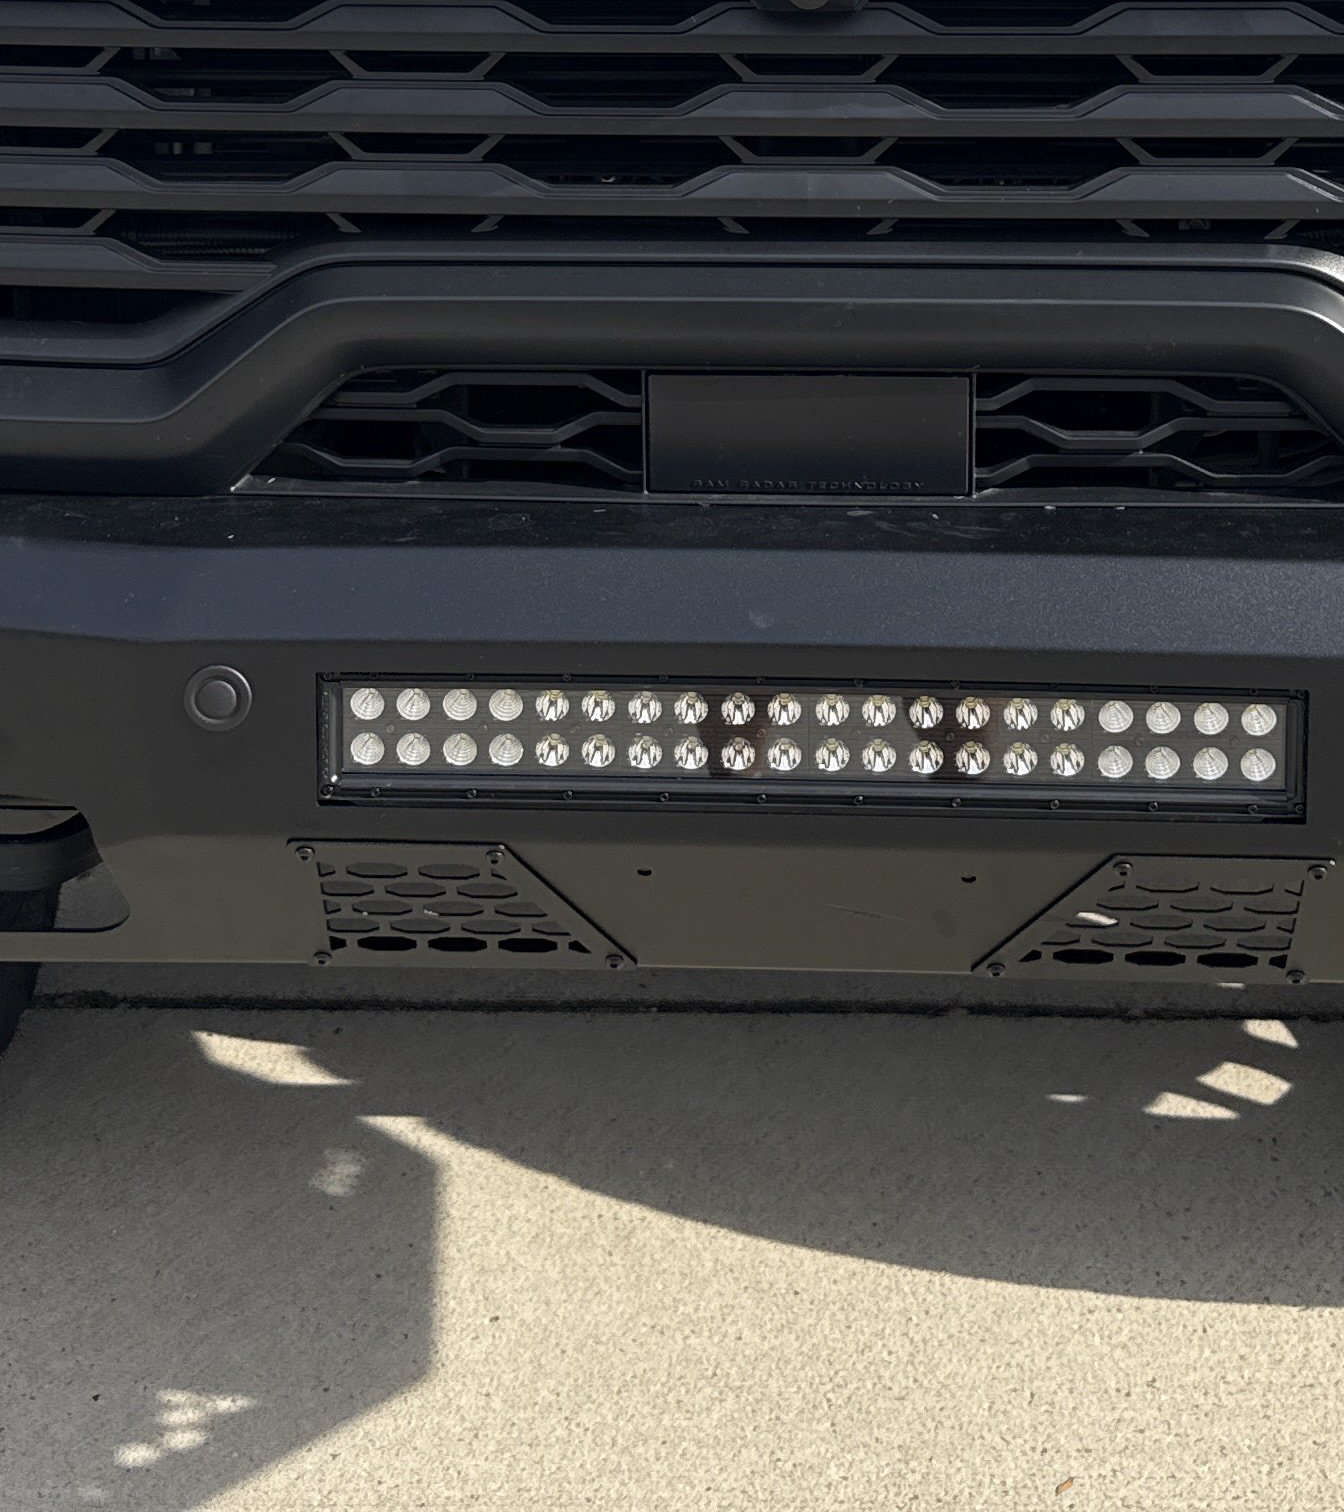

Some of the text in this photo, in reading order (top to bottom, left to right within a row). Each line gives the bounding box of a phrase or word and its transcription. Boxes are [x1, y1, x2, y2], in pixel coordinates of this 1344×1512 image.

[693, 479, 924, 491] RAM RADAR TECHNOLOGY
